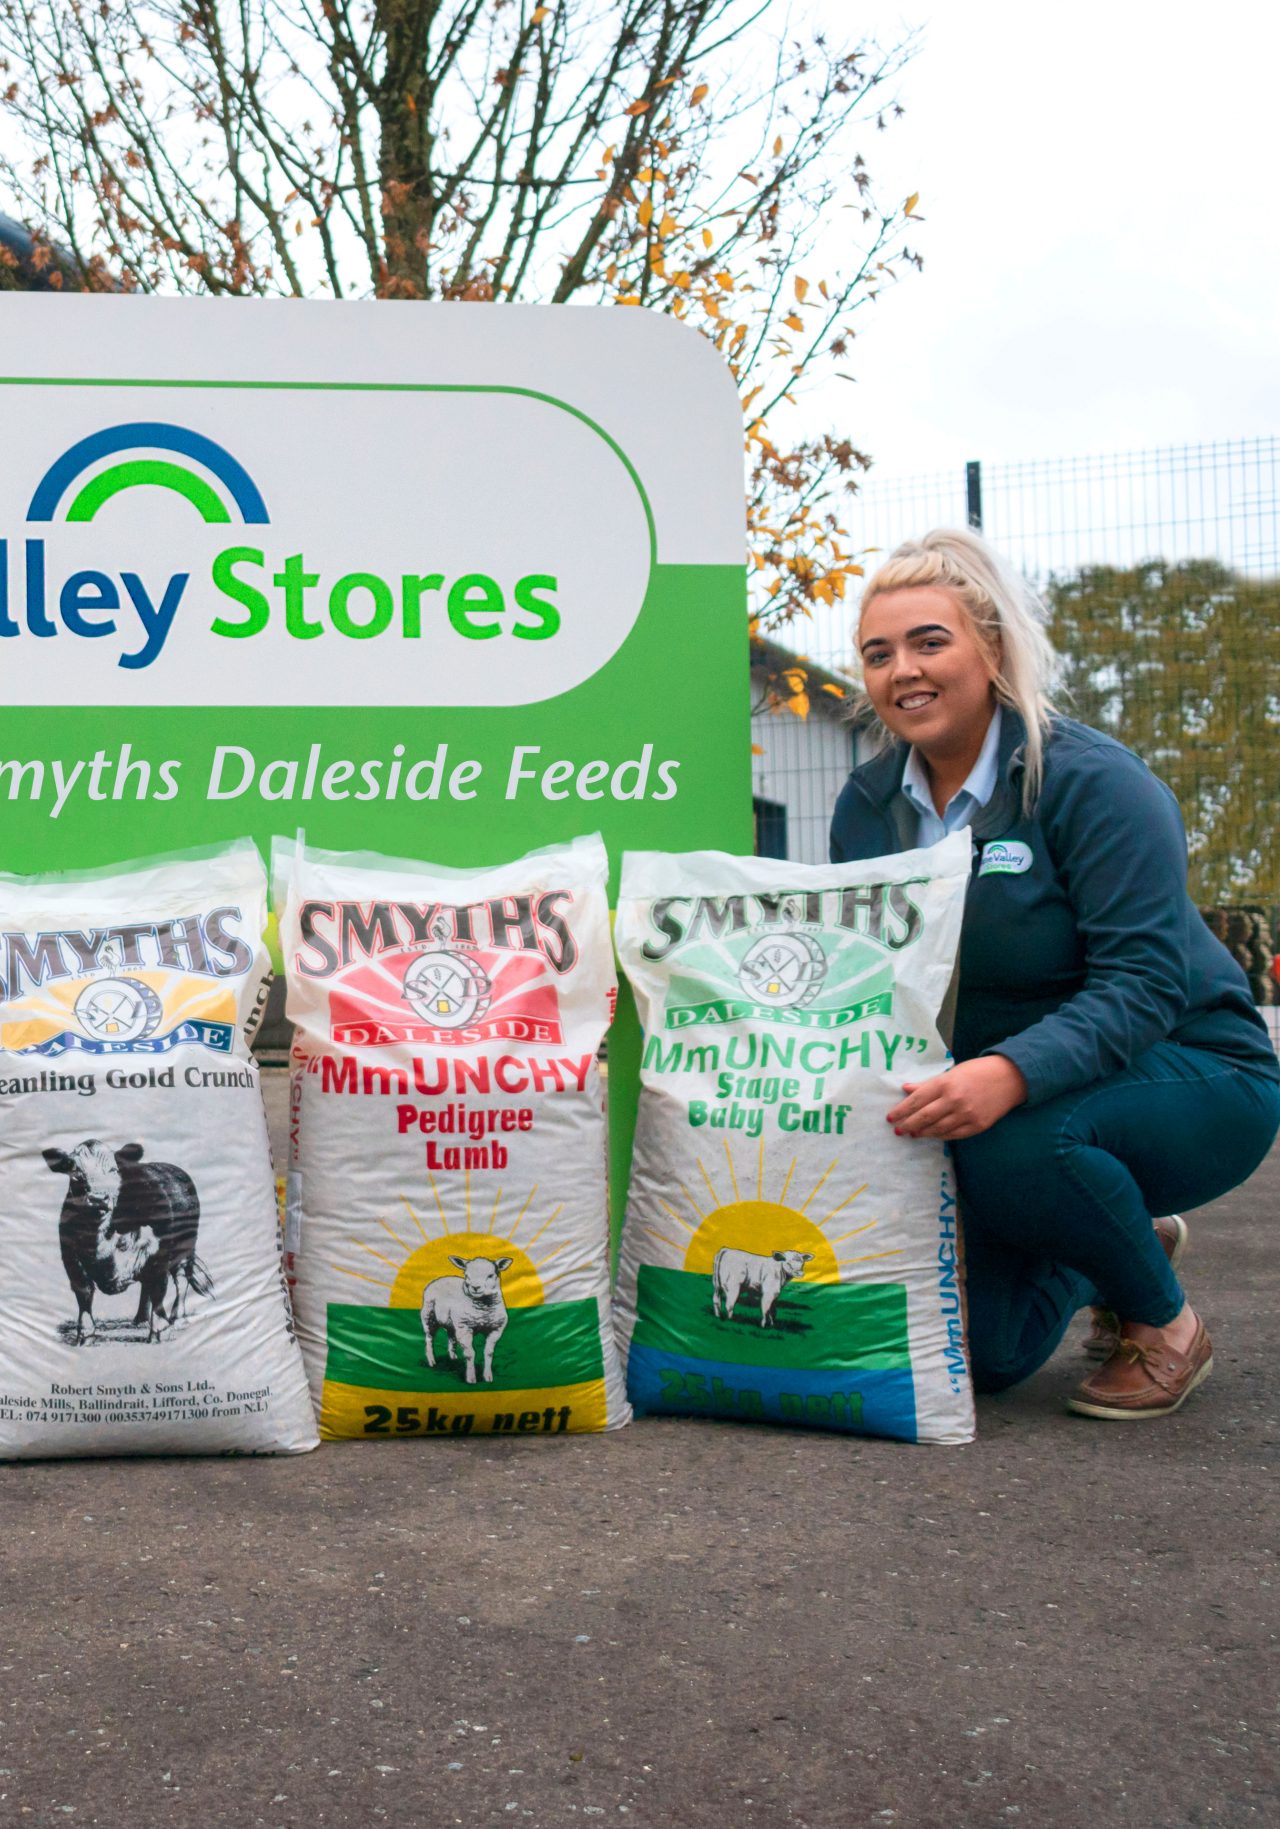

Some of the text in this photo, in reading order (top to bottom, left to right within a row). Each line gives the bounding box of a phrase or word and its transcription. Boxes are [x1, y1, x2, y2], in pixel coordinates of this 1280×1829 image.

[210, 547, 561, 640] Stores
[207, 744, 484, 801] Daleside
[505, 744, 681, 801] Feeds
[295, 890, 578, 978] SMYTHS
[641, 876, 930, 961] SMYTHS
[671, 998, 881, 1028] DALESIDE
[340, 1020, 553, 1045] DALESIDE
[105, 1066, 175, 1090] Gold
[184, 1065, 256, 1089] Crunch
[716, 1071, 801, 1105] Stage
[396, 1104, 533, 1141] Pedigree
[688, 1099, 853, 1138] Baby Calf
[425, 1140, 508, 1171] Lamb
[40, 1398, 76, 1411] Mills,
[203, 1393, 224, 1406] Co.
[51, 1383, 93, 1396] Robert
[96, 1384, 136, 1398] Smyth
[140, 1383, 151, 1395] &
[155, 1382, 183, 1394] Sons
[26, 1411, 47, 1422] 074
[51, 1411, 101, 1423] 9171300
[212, 1407, 241, 1418] from
[244, 1401, 269, 1414] N.I.)
[363, 1404, 572, 1434] 25kg nett
